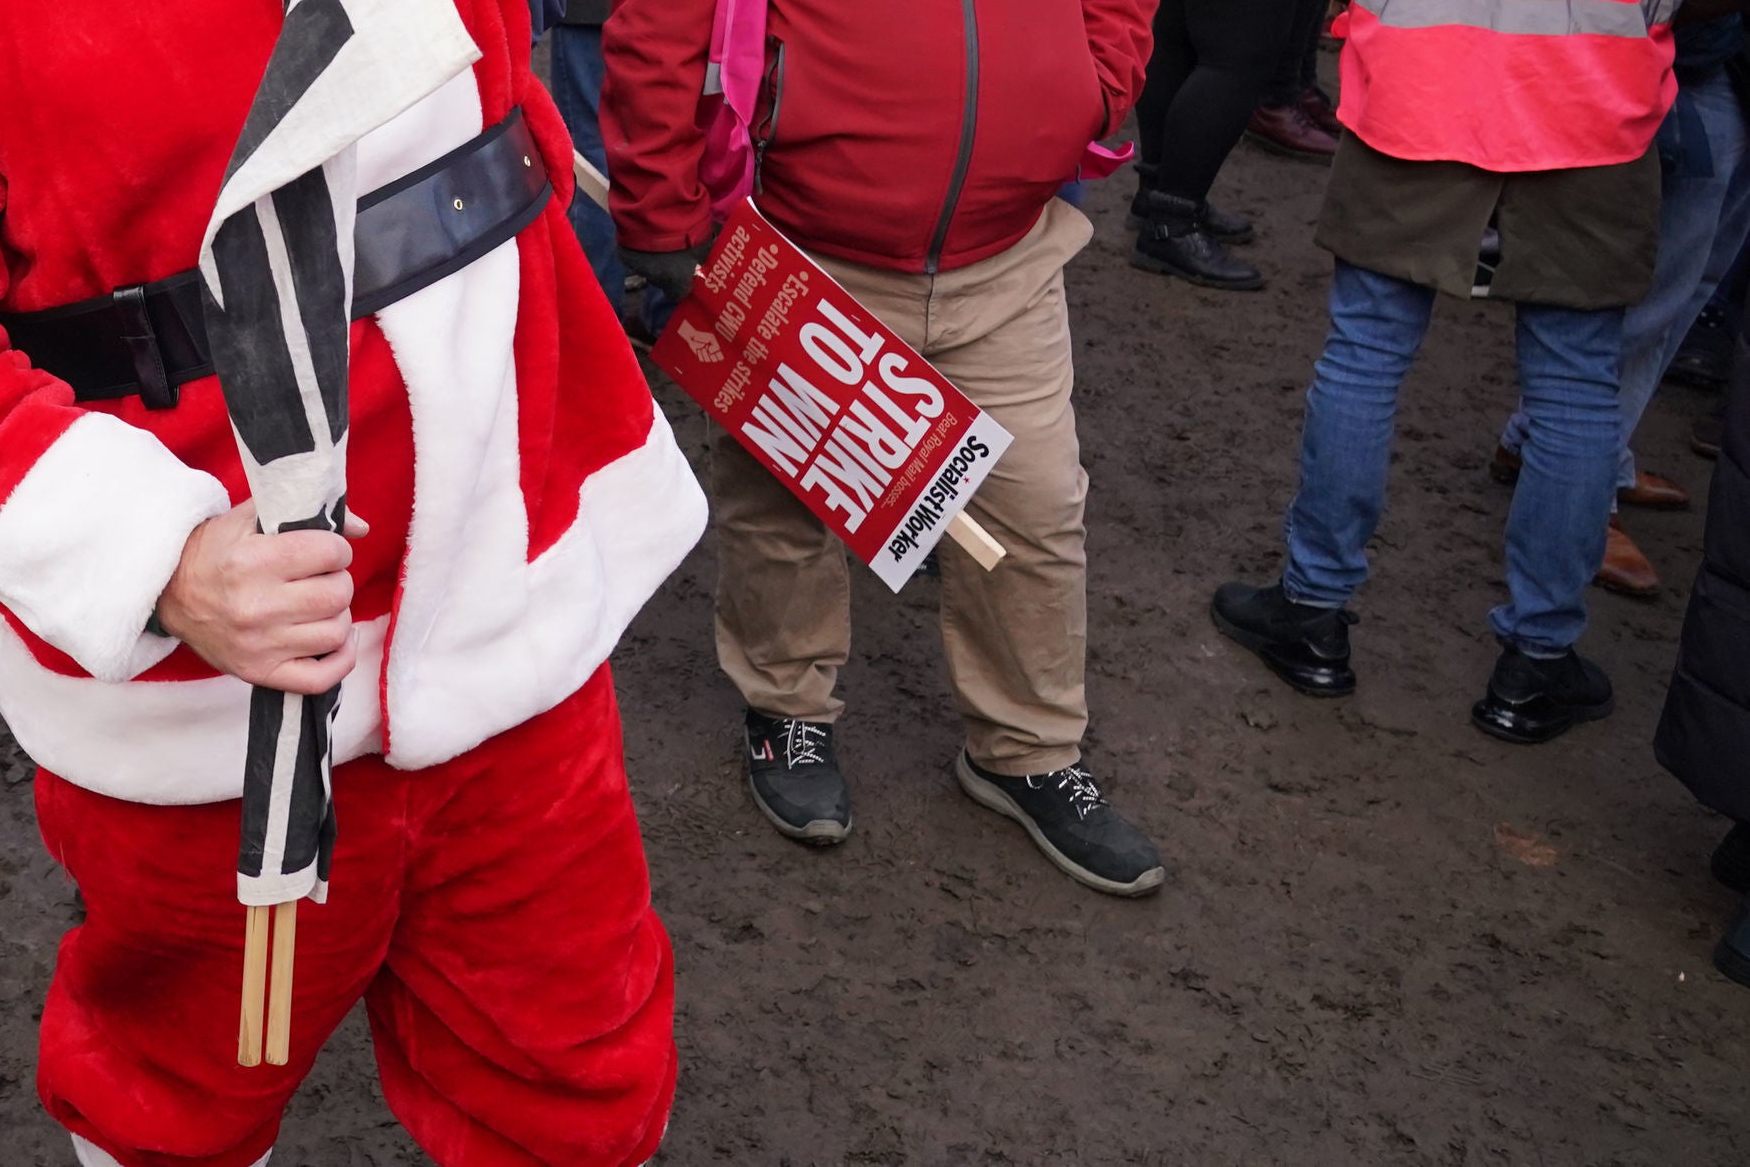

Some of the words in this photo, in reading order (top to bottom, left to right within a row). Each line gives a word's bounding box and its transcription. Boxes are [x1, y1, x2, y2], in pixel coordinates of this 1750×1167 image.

[704, 225, 750, 294] activists
[715, 301, 747, 343] CWU
[799, 298, 886, 385] TO
[743, 335, 770, 365] the
[713, 361, 752, 413] strikes
[741, 362, 841, 479] WIN
[800, 352, 945, 535] STRIKE
[937, 412, 958, 436] Beat
[918, 432, 942, 459] Royal
[908, 458, 927, 483] Mail
